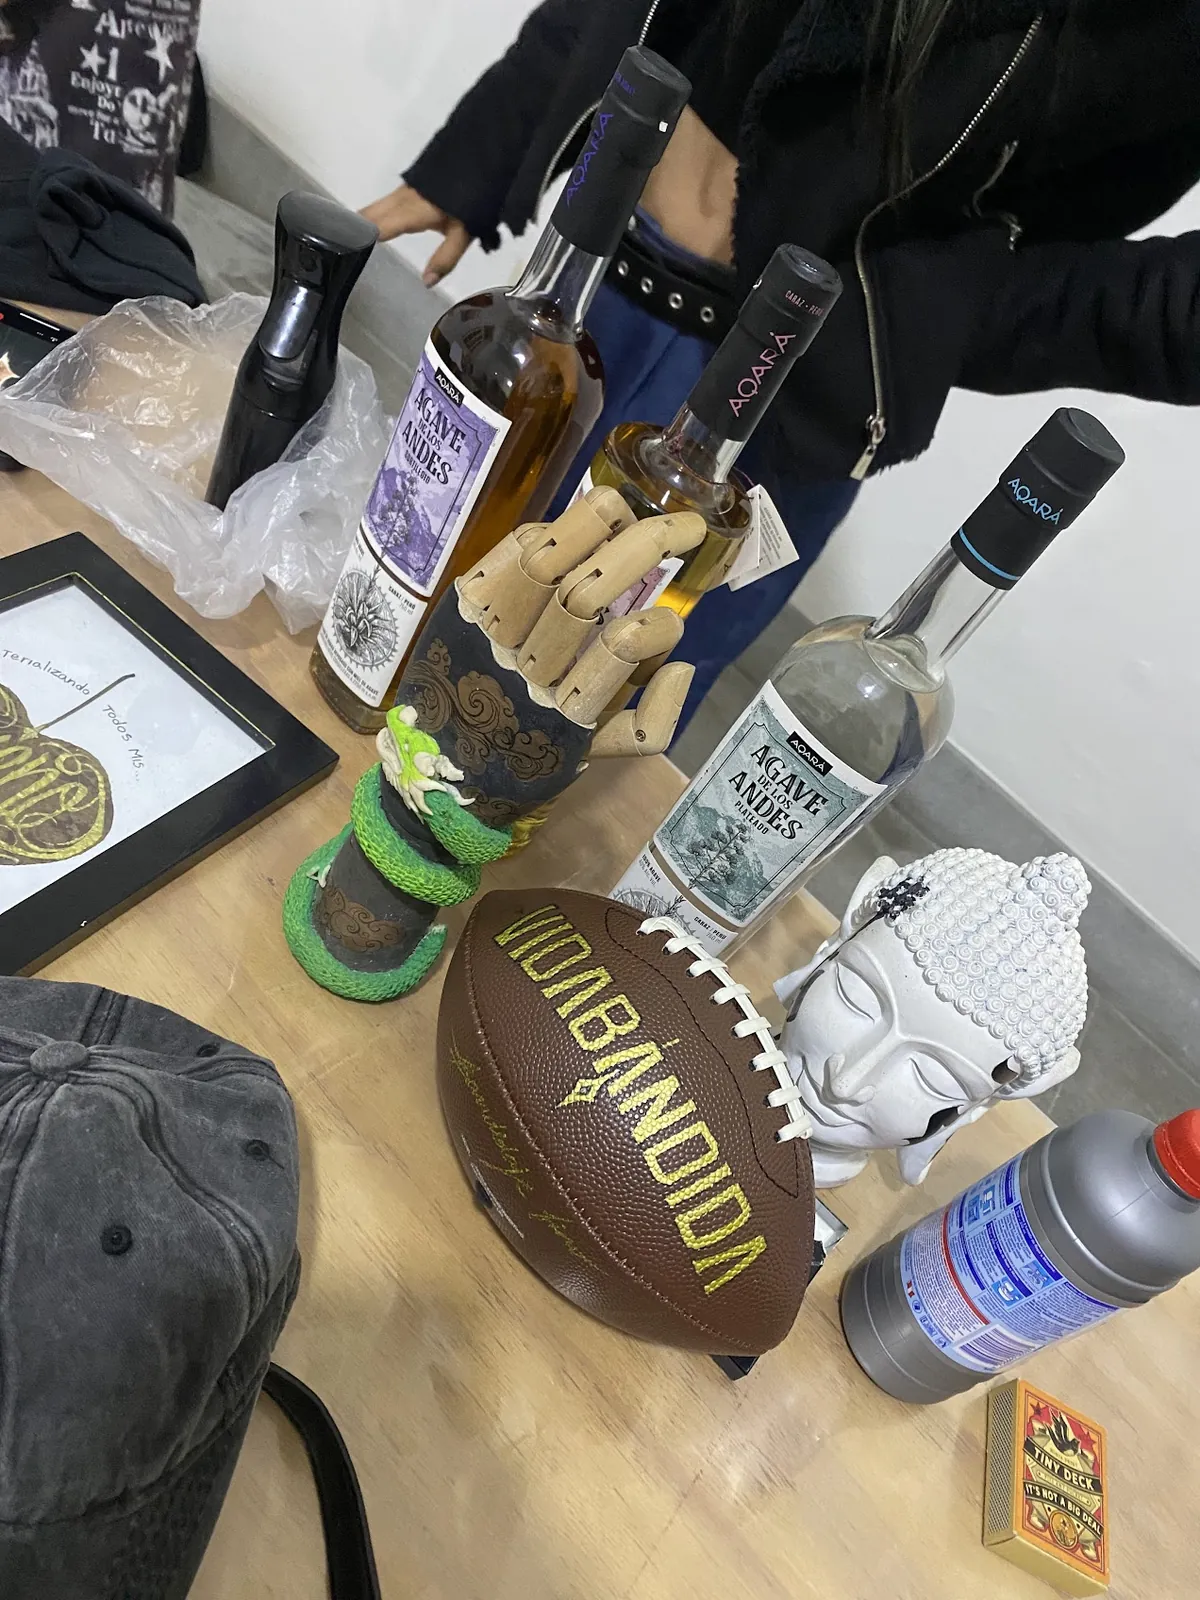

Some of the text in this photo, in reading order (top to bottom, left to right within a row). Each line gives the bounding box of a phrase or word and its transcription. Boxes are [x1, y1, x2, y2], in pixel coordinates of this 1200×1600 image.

[436, 374, 461, 403] AQARÁ
[728, 331, 796, 417] AQARÁ
[414, 388, 467, 454] AGAVE
[418, 418, 443, 450] DE LOS
[402, 420, 453, 485] ANDES
[1007, 477, 1064, 525] AQARÁ
[790, 740, 826, 772] AQARÁ
[750, 744, 830, 816] AGAVE
[757, 774, 794, 810] DE LOS
[728, 770, 804, 840] ANDES
[734, 800, 769, 835] PLATEADO
[649, 866, 661, 883] AGAVE
[1034, 1446, 1060, 1474] TINY
[1063, 1468, 1095, 1492] DECK
[1025, 1484, 1041, 1497] IT'S
[1041, 1488, 1058, 1502] NOT
[1060, 1497, 1066, 1508] A
[1067, 1502, 1081, 1517] BIG
[1082, 1511, 1102, 1535] DEAL
